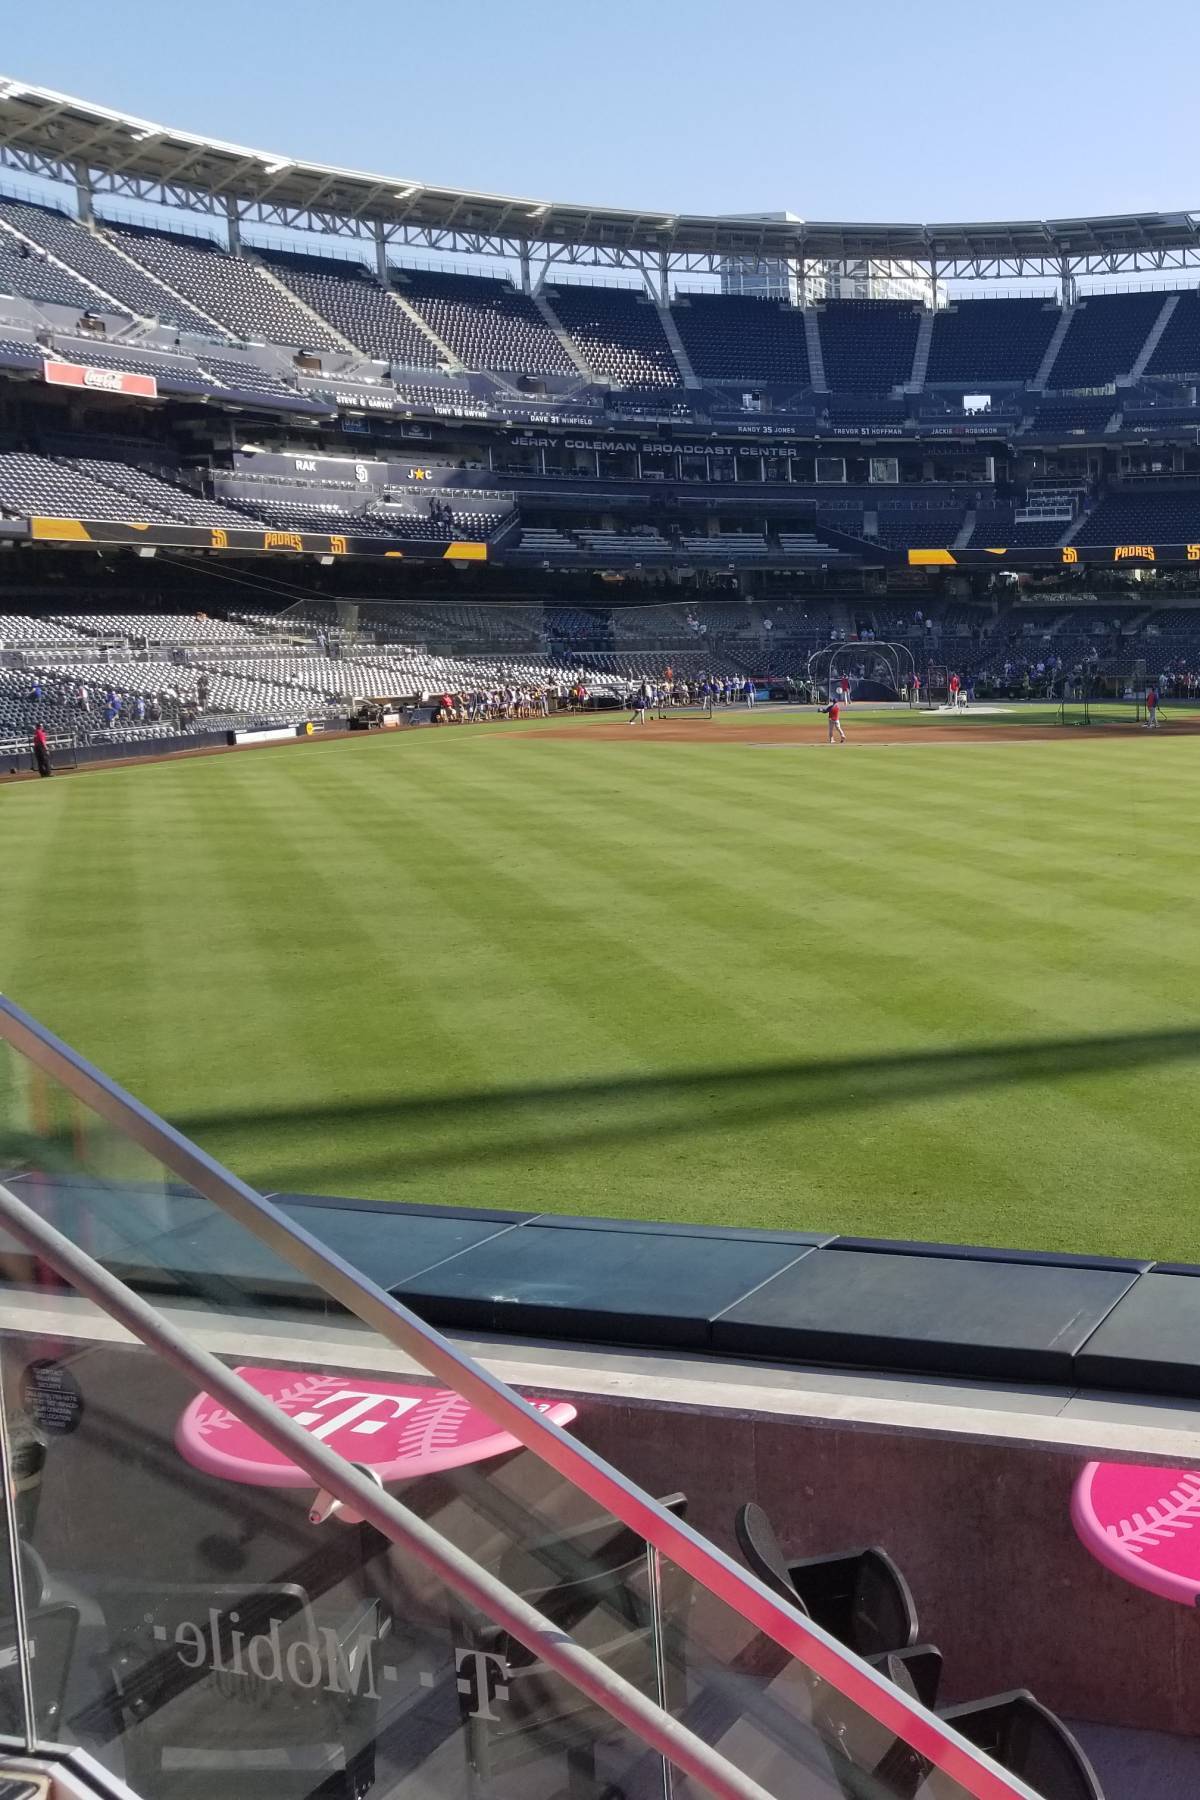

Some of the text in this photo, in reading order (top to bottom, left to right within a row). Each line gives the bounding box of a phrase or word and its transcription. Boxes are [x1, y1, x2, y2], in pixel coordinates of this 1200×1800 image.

[336, 396, 358, 404] STEVE
[433, 406, 451, 415] TONY
[530, 415, 593, 425] DAVE 31 WINFIELD
[762, 426, 773, 434] 35
[861, 427, 870, 435] 51
[931, 427, 953, 435] JACKIE
[511, 436, 798, 457] JERRY COLEMAN BROADCAST CENTER
[295, 460, 317, 472] RAK
[264, 532, 304, 551] PADRES
[1114, 546, 1155, 561] PADRES
[304, 1390, 423, 1448] T
